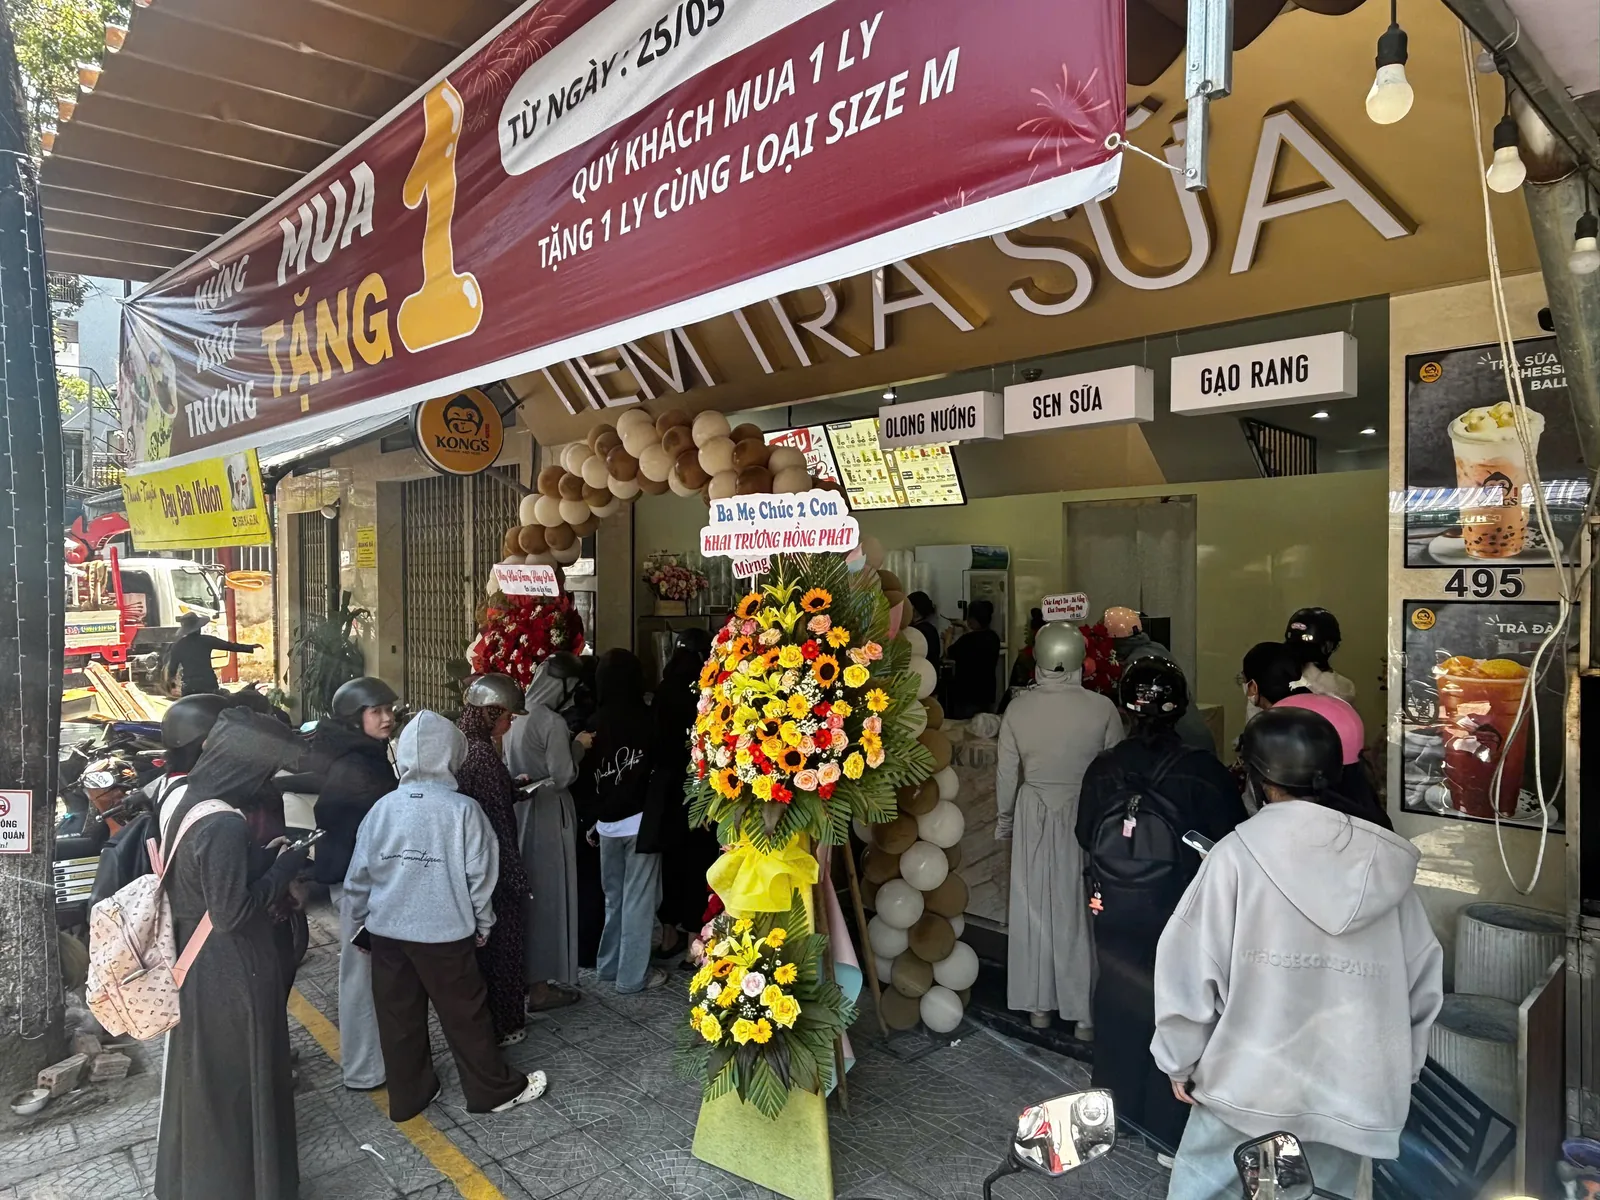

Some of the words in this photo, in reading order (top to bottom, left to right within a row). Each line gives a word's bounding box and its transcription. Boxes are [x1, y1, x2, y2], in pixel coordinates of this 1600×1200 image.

[507, 99, 541, 146] TỪ
[547, 52, 619, 126] NGÀY
[571, 139, 619, 204] QUÝ
[624, 98, 715, 176] KHÁCH
[723, 58, 796, 128] MUA
[808, 41, 825, 85] 1
[836, 10, 884, 73] LY
[538, 217, 594, 272] TẶNG
[600, 208, 612, 243] 1
[619, 191, 648, 236] LY
[653, 154, 731, 219] CÙNG
[739, 112, 819, 184] LOẠI
[825, 69, 910, 145] SIZE
[918, 46, 961, 106] M
[277, 161, 375, 287] MUA
[261, 272, 394, 413] TẶNG
[1524, 352, 1558, 366] SỮA
[1200, 363, 1241, 397] GẠO
[1250, 354, 1309, 389] RANG
[184, 379, 257, 438] TRƯƠNG
[1032, 393, 1062, 420] SEN
[1069, 383, 1103, 414] SỮA
[885, 412, 925, 439] OLONG
[930, 404, 976, 433] NƯỚNG
[434, 434, 490, 453] KONG'S
[192, 477, 224, 515] Violon
[716, 503, 734, 523] Ba
[736, 501, 756, 526] Mẹ
[758, 499, 794, 520] Chúc
[796, 501, 807, 518] 2
[809, 497, 838, 517] Con
[704, 534, 732, 552] KHAI
[734, 528, 781, 550] TRƯƠNG
[782, 521, 816, 548] HỒNG
[818, 523, 854, 546] PHÁT
[734, 556, 770, 578] Mừng
[1444, 567, 1525, 598] 495
[1496, 621, 1529, 634] TRÀ
[1532, 621, 1566, 634] ĐÀ
